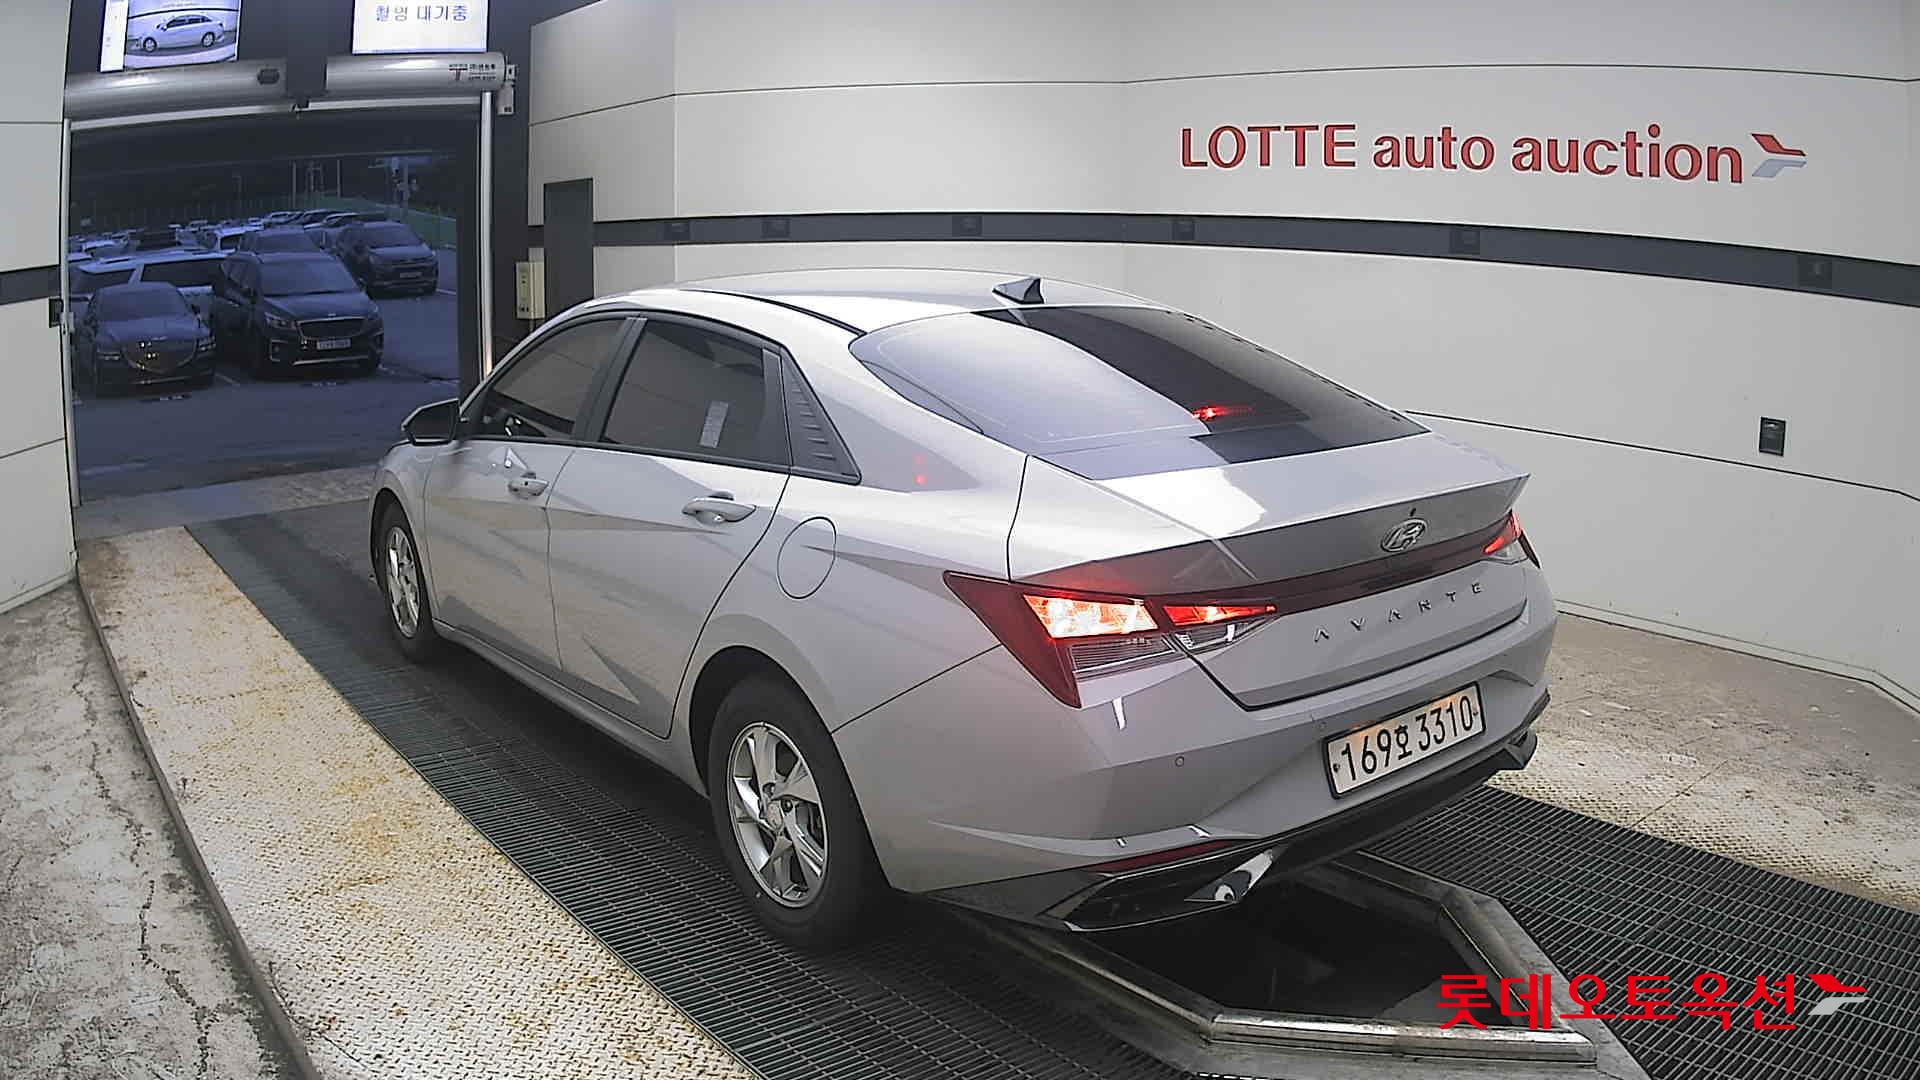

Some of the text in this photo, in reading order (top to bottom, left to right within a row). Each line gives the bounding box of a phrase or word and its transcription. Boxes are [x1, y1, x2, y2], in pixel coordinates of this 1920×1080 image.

[416, 5, 468, 23] 대기중
[1181, 123, 1743, 184] LOTTE auto auction
[1415, 695, 1474, 752] 3310
